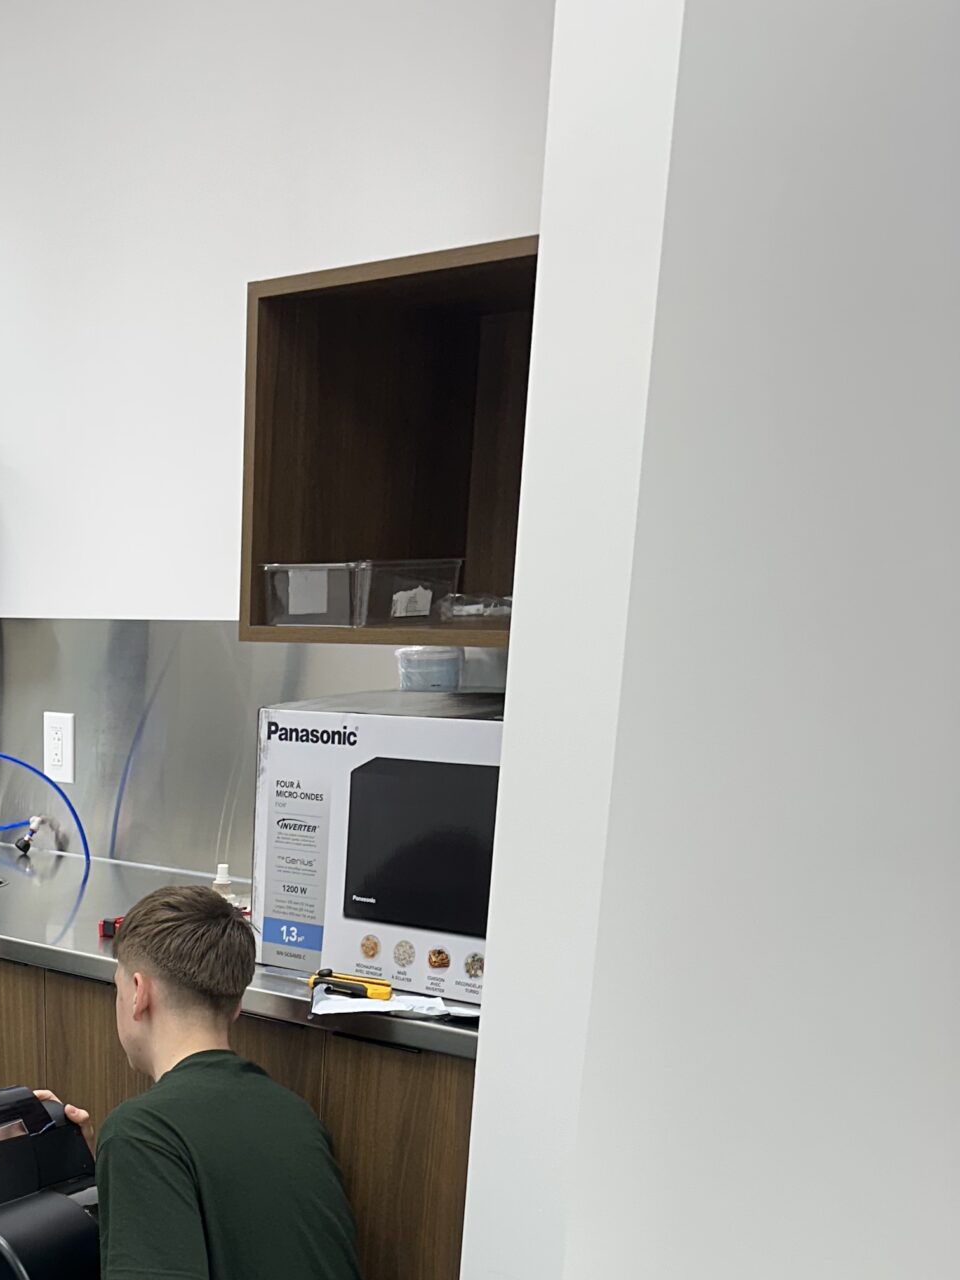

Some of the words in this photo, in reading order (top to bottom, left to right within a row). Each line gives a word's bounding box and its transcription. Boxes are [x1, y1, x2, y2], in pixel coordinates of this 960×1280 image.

[267, 721, 358, 746] Panasonic
[276, 780, 295, 789] FOUR
[276, 790, 324, 801] MICRO-ONDES
[280, 822, 317, 833] INVERTER
[282, 884, 299, 894] 1200
[300, 887, 308, 895] W
[280, 925, 298, 943] 1,3
